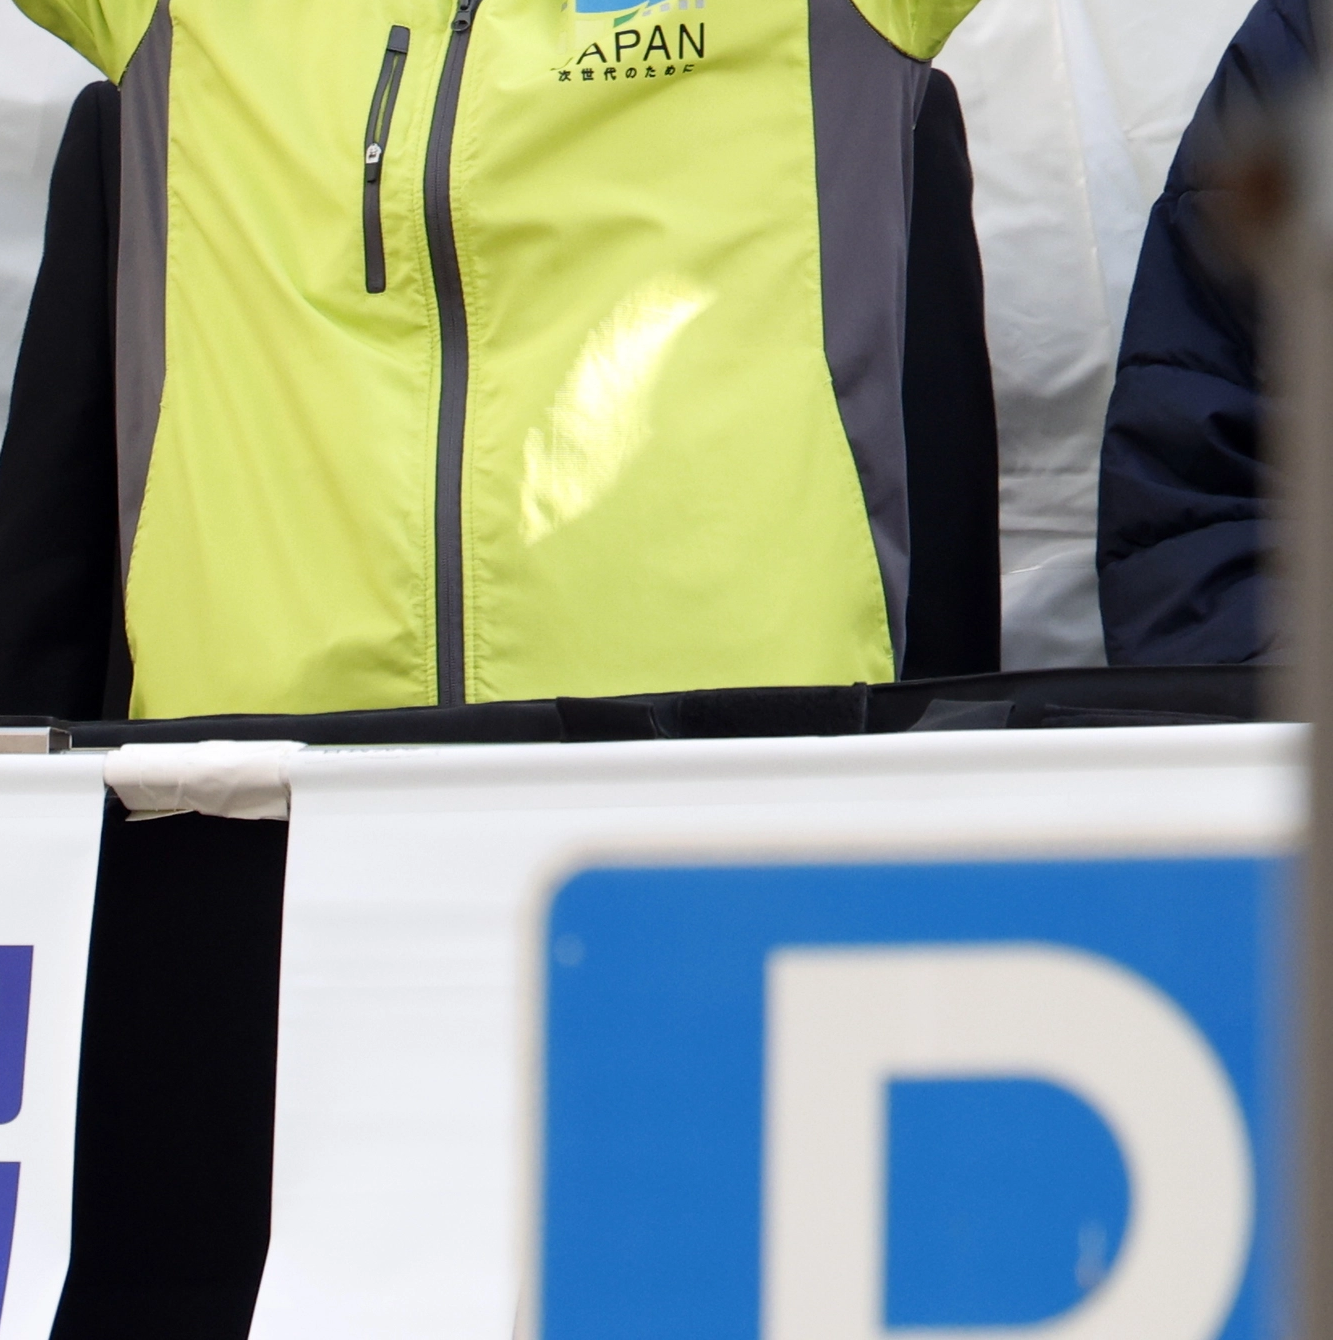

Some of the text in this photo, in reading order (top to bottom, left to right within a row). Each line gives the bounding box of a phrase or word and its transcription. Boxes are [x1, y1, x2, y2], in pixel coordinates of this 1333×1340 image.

[558, 64, 695, 82] 次世代のために
[757, 940, 1257, 1340] P
